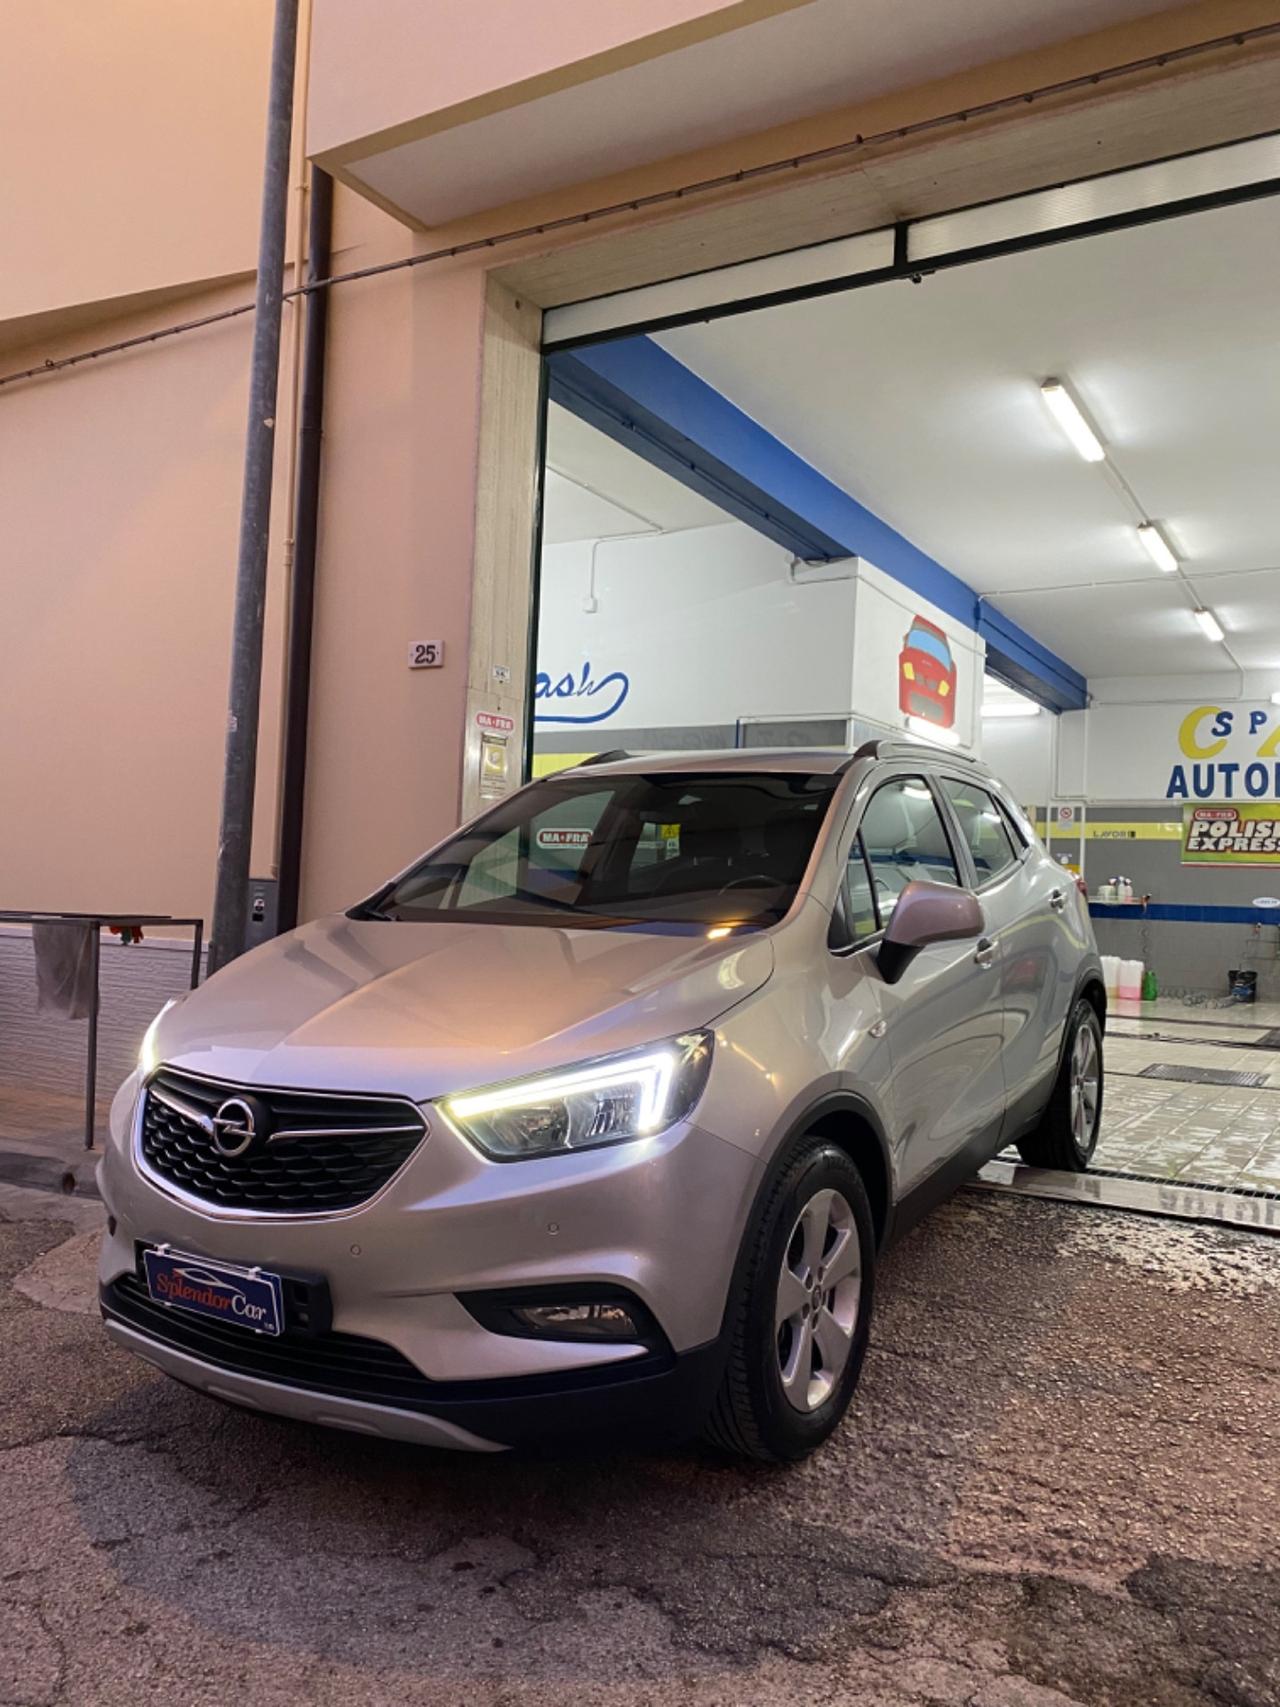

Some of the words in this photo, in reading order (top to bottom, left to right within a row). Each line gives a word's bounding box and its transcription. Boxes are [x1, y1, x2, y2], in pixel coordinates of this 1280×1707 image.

[414, 645, 436, 664] 25
[1166, 763, 1280, 798] AUTO
[1187, 837, 1280, 851] EXPRES
